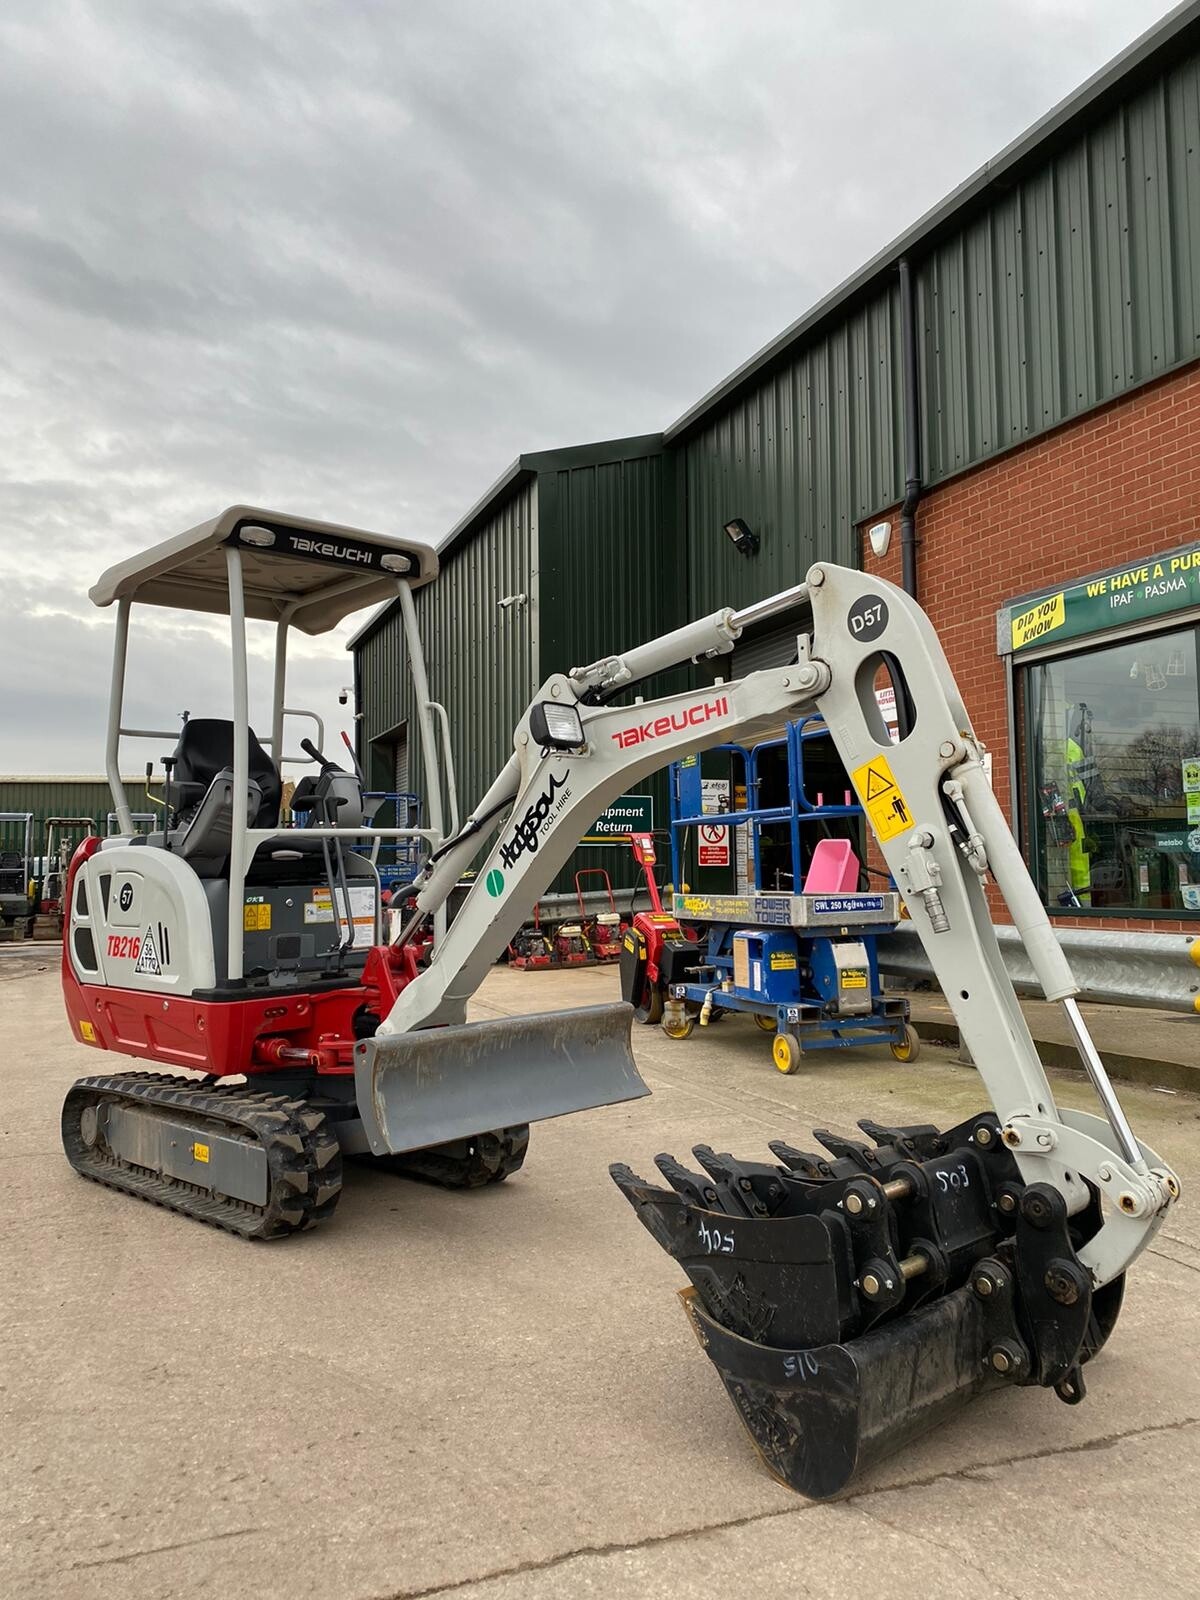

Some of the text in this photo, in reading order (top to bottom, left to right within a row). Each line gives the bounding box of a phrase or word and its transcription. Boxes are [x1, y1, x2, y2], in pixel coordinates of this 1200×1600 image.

[289, 536, 373, 564] TAKEUCHI
[1086, 581, 1107, 598] WE
[1111, 568, 1149, 591] HAVE
[1153, 564, 1164, 580] A
[1110, 577, 1187, 608] IPAF PASMA
[851, 603, 882, 634] D57
[1017, 599, 1058, 630] DID YOU
[1023, 617, 1054, 643] KNOW
[611, 697, 728, 749] TAKEUCHI
[540, 788, 573, 836] TOOL HIRE
[601, 807, 645, 819] ipment
[596, 821, 633, 832] Return
[1158, 839, 1184, 847] metabo
[121, 891, 132, 905] 57
[755, 898, 791, 911] POWER
[815, 901, 830, 911] SWL
[831, 900, 842, 910] 250
[755, 912, 791, 925] TOWER
[108, 935, 140, 960] TB216
[144, 943, 153, 957] 36
[936, 1165, 970, 1193] 503
[698, 1219, 735, 1254] 504
[783, 1352, 818, 1382] 510
